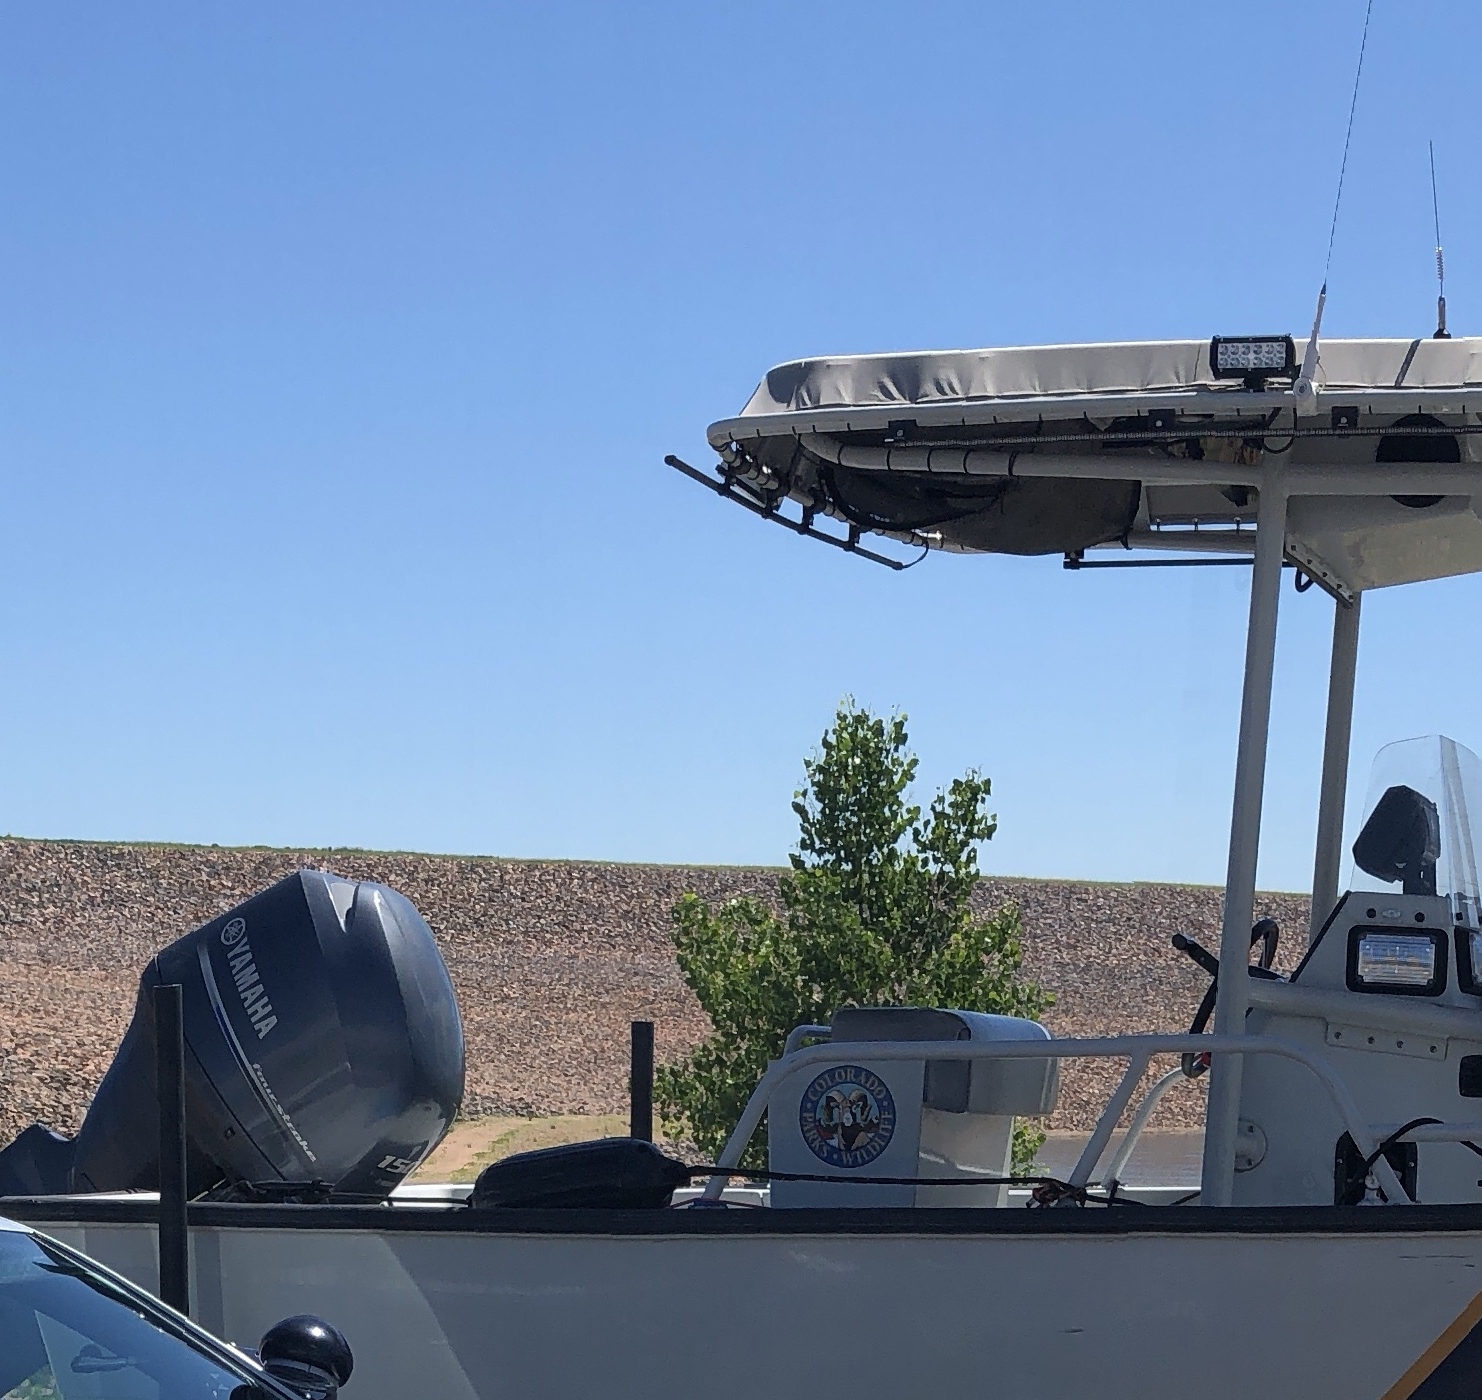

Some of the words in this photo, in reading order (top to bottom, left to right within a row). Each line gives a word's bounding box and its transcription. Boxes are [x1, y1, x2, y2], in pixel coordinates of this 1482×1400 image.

[225, 937, 278, 1040] YAMAHA
[808, 1068, 886, 1100] COLORADO
[802, 1111, 830, 1158] PARKS
